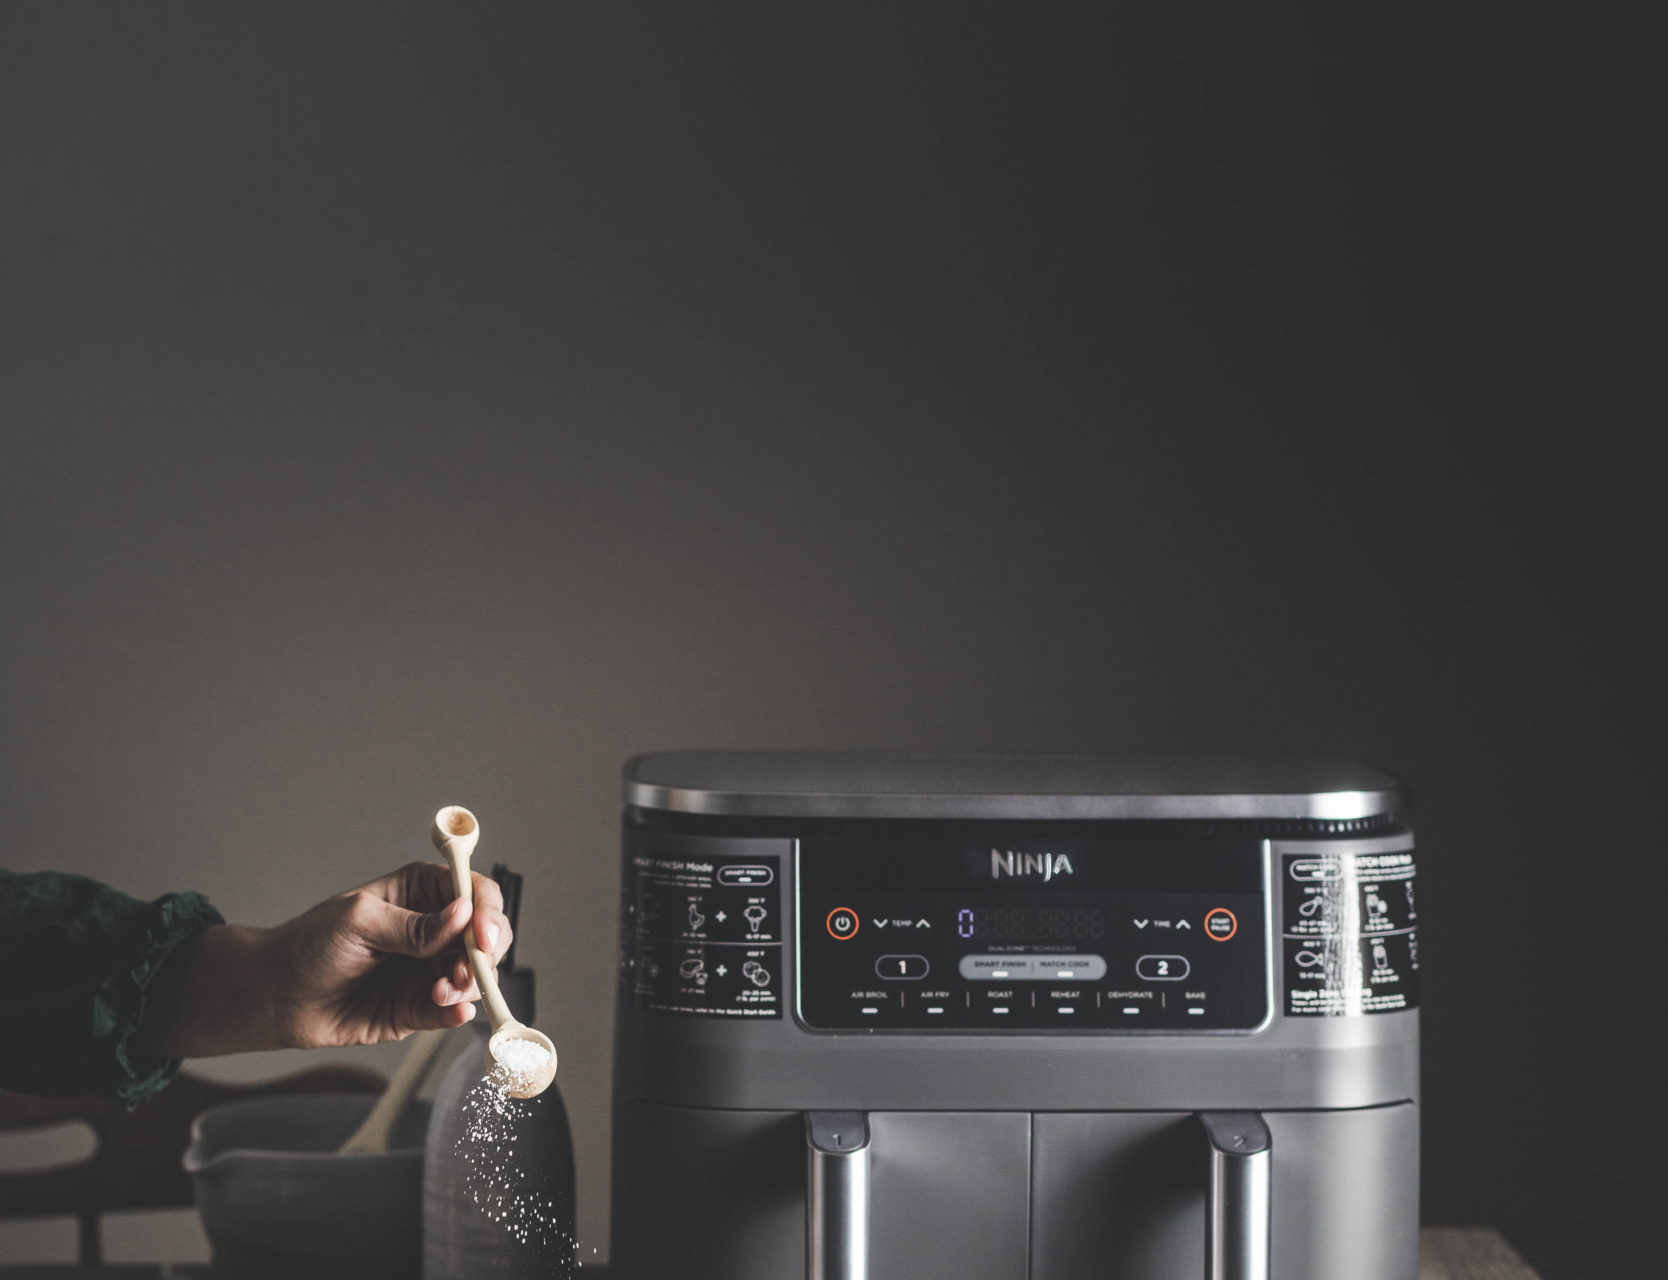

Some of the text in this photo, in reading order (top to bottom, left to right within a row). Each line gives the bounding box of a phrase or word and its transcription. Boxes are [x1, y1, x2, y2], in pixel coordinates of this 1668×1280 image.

[686, 862, 713, 872] Mode
[991, 848, 1073, 882] NINJA
[1153, 920, 1170, 928] TIME
[898, 960, 906, 975] 1
[1157, 960, 1169, 975] 2
[1050, 991, 1080, 999] REHEAT
[1107, 991, 1153, 999] DEHYDRATE
